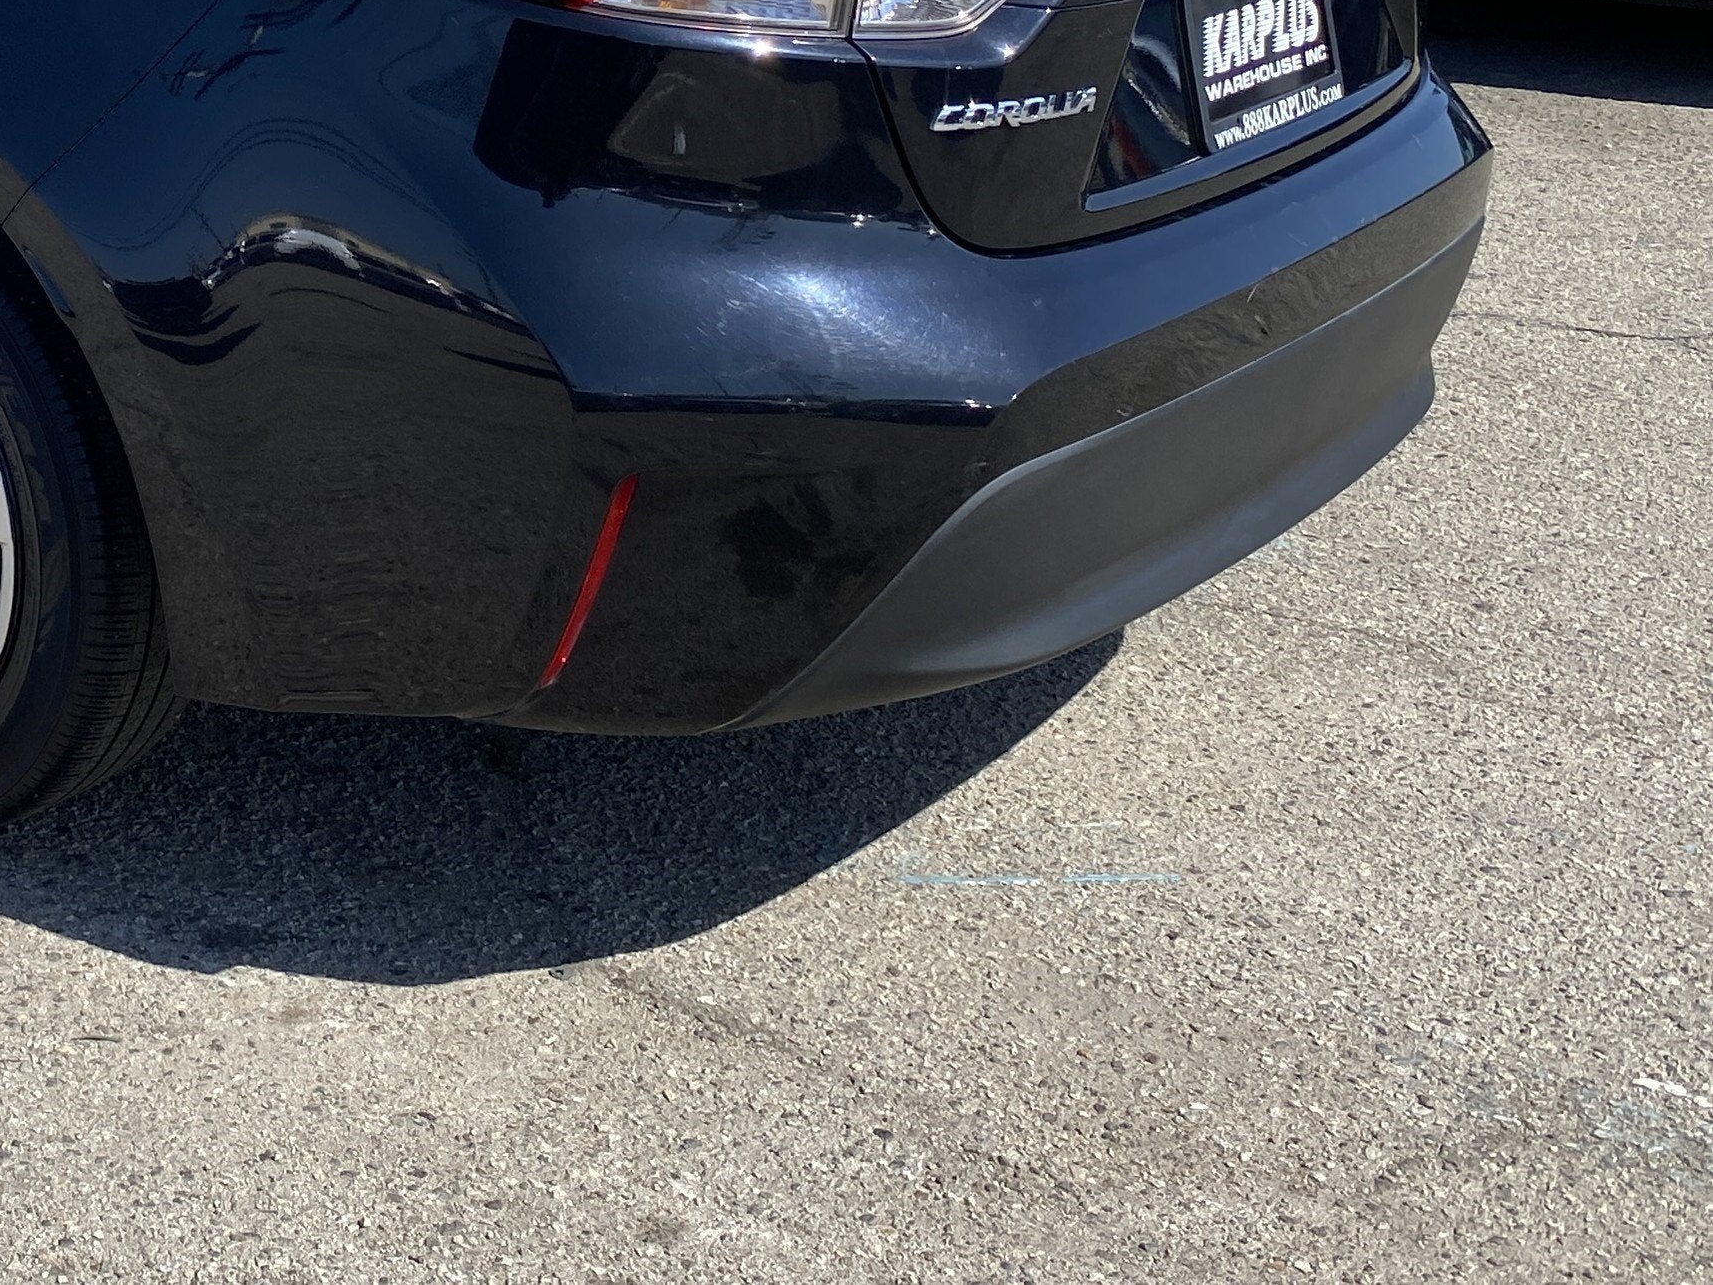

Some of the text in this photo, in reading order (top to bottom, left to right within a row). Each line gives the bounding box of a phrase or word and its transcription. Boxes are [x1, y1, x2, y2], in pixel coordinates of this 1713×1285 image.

[1205, 44, 1328, 102] WAREHOUSE INC
[930, 86, 1097, 132] COROLLA
